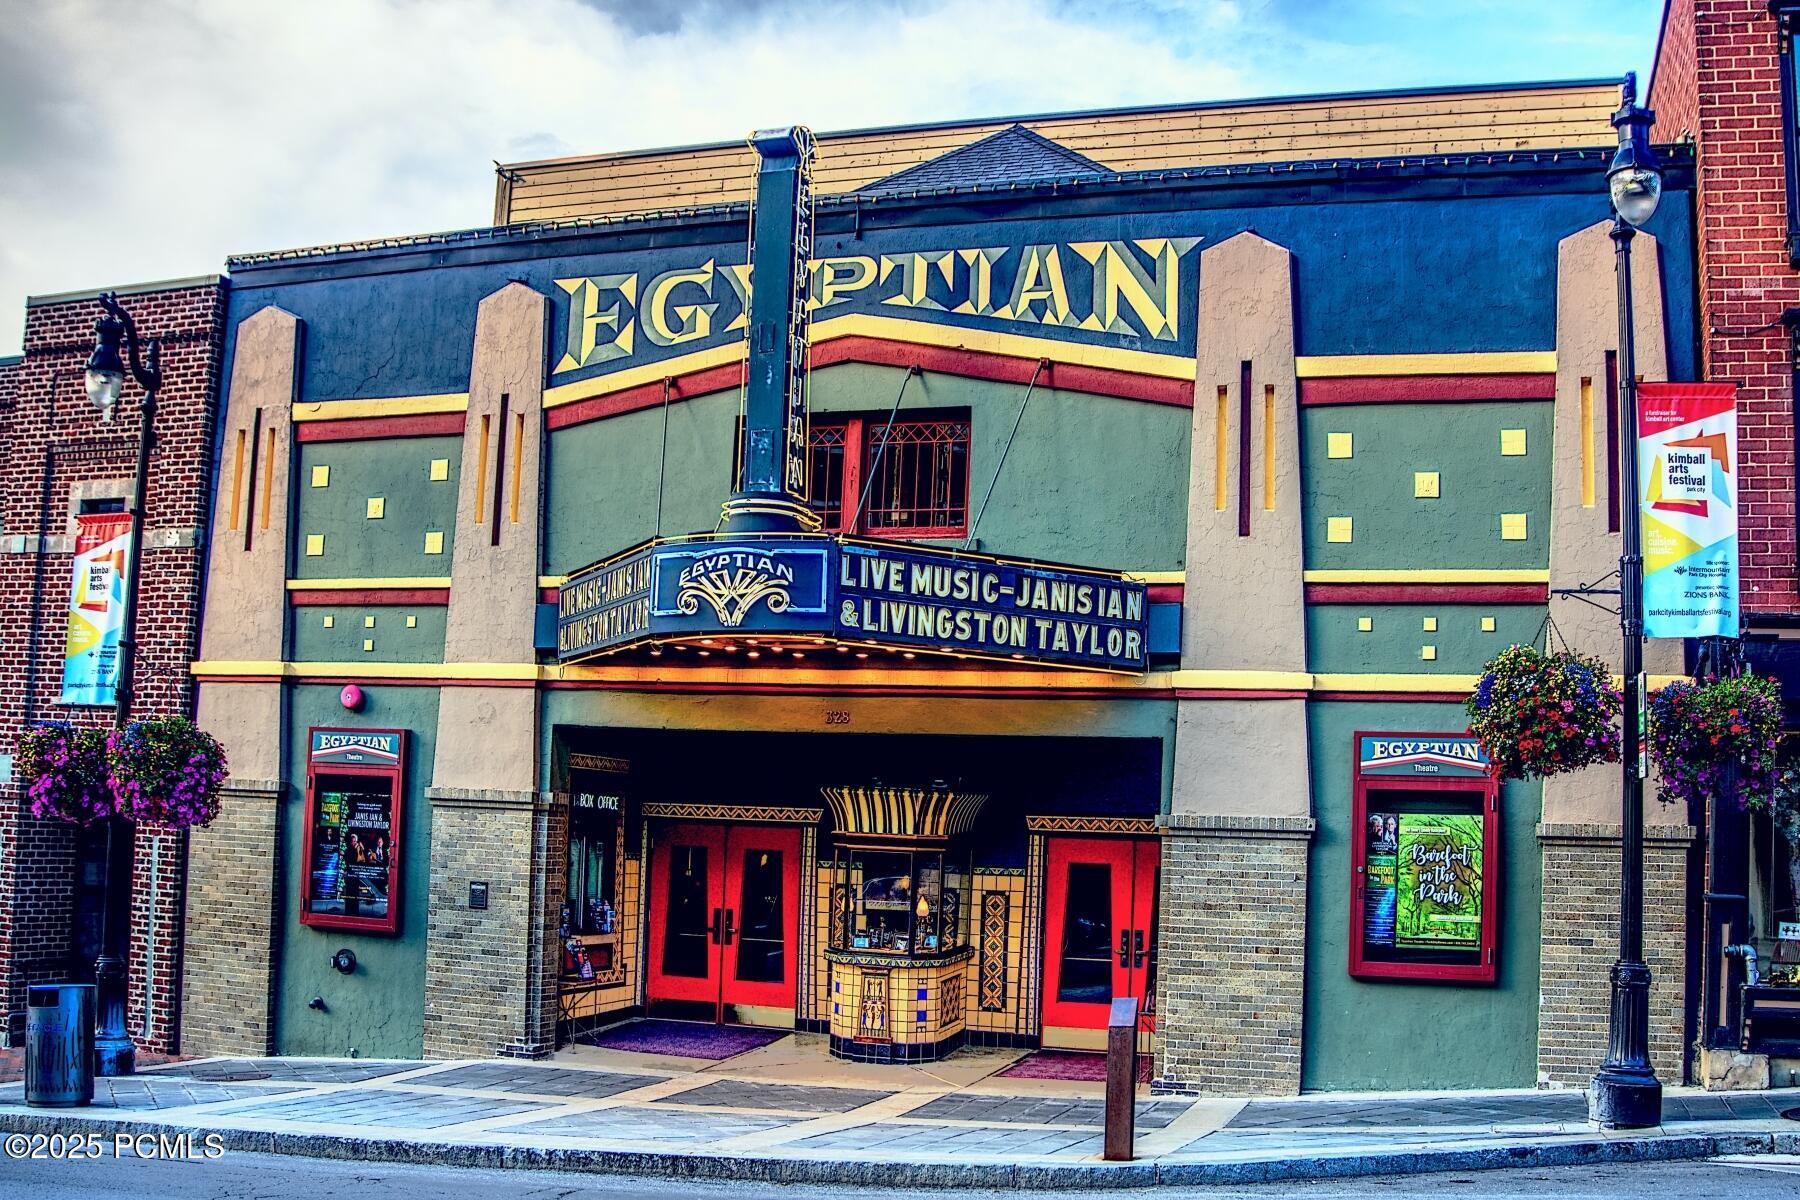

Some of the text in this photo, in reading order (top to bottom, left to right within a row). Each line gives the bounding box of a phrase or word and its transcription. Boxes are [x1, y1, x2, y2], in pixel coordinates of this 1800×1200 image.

[1667, 453, 1706, 465] kimball
[1668, 464, 1689, 474] arts
[1668, 474, 1706, 486] festival
[90, 566, 111, 574] kimba
[679, 553, 794, 587] EGYPTIAN
[560, 587, 576, 619] LIVE
[633, 557, 651, 593] IAN
[840, 554, 906, 593] LIVE
[1097, 587, 1143, 621] IAN
[1684, 591, 1707, 599] ZIONS
[610, 597, 650, 638] TAYLOR
[1035, 618, 1142, 660] TAYLOR
[826, 710, 849, 724] 328
[320, 734, 392, 752] EGYPTIAN
[1372, 741, 1481, 760] EGYPTIAN
[346, 753, 363, 761] Theatre
[1414, 764, 1439, 772] Theatre
[580, 793, 620, 810] BOX OFFICE
[348, 819, 373, 828] LIVINGSTON
[354, 812, 369, 821] JANIS
[370, 813, 379, 821] IAN
[1407, 843, 1479, 870] Barefoot
[1419, 866, 1457, 885] in the
[1413, 883, 1462, 905] Park
